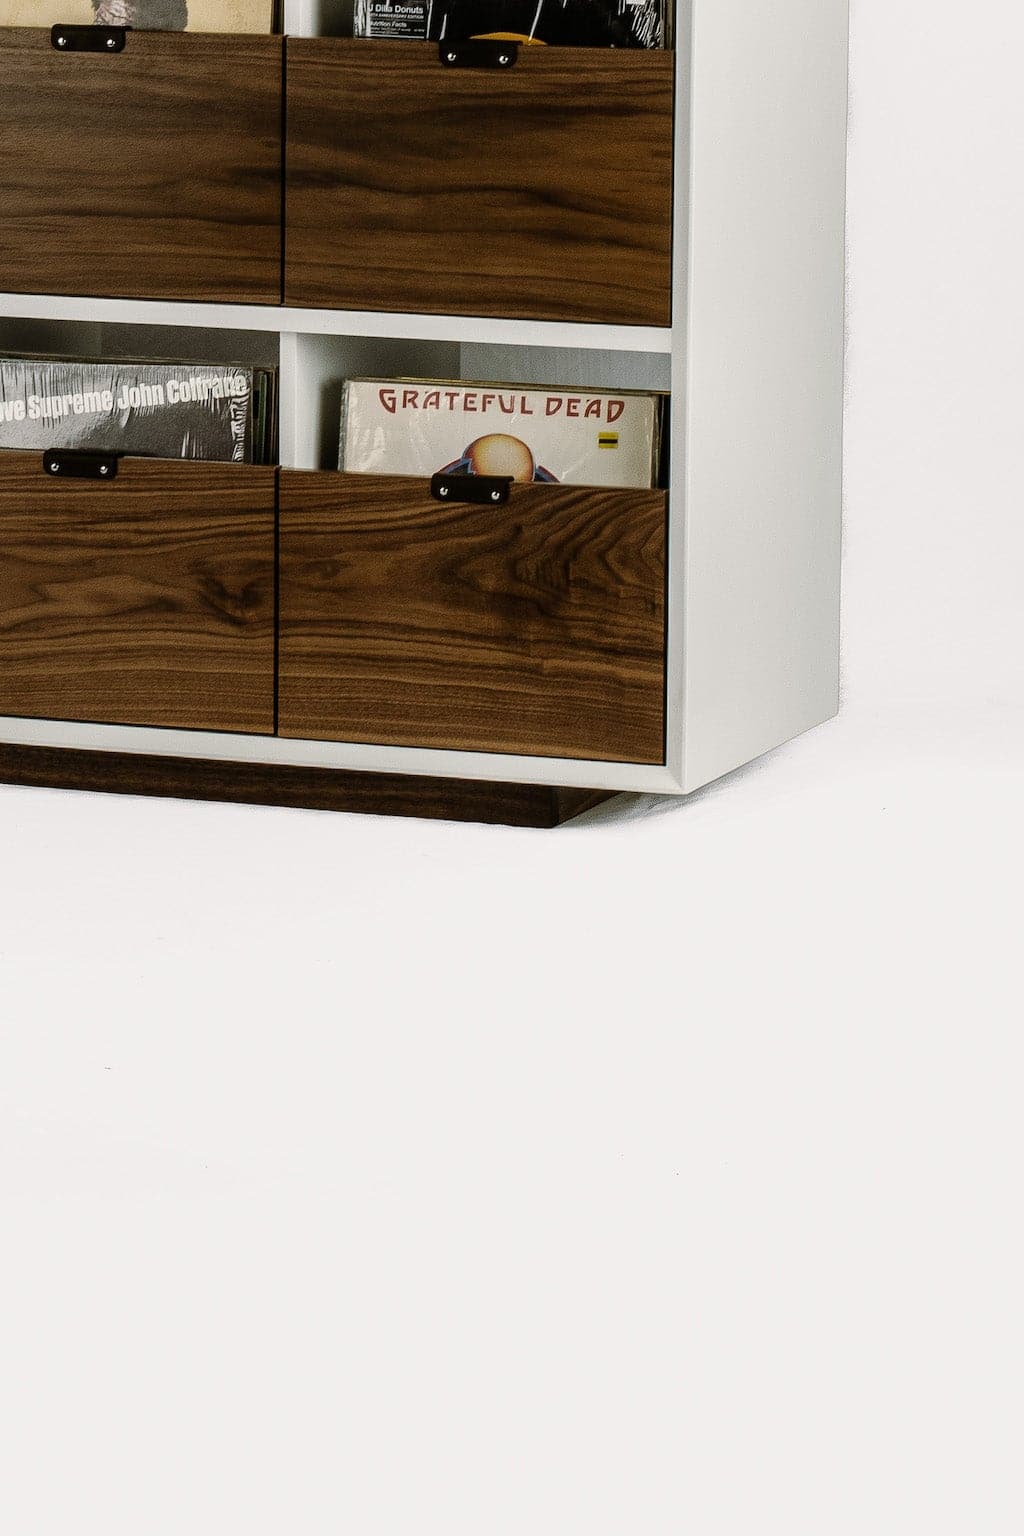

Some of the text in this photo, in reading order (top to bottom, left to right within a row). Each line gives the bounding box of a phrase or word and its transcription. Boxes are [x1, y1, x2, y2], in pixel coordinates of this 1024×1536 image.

[394, 5, 424, 14] Donuts
[28, 390, 114, 419] Supreme
[117, 382, 165, 410] John
[167, 375, 249, 403] Coltrane
[379, 389, 625, 423] GRATEFUL DEAD
